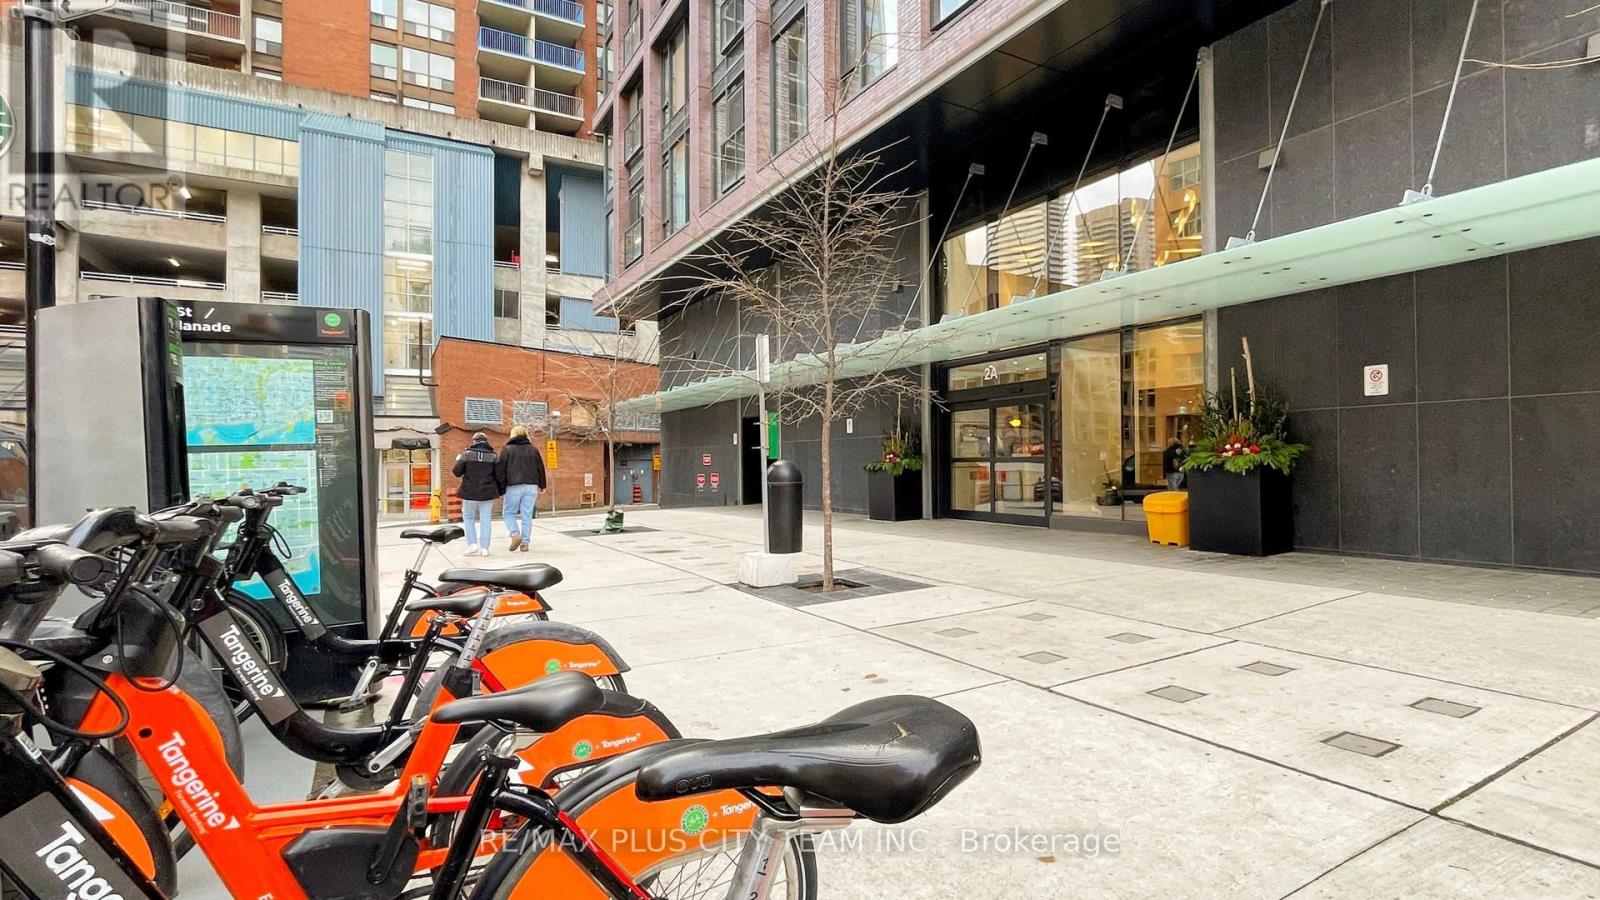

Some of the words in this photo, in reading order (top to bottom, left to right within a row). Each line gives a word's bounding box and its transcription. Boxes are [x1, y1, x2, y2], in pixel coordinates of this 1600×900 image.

[984, 366, 999, 380] 2A
[278, 578, 313, 623] Tangerine
[220, 624, 274, 695] Tangerine
[602, 735, 638, 749] Tangerine
[158, 731, 226, 828] Tangerine
